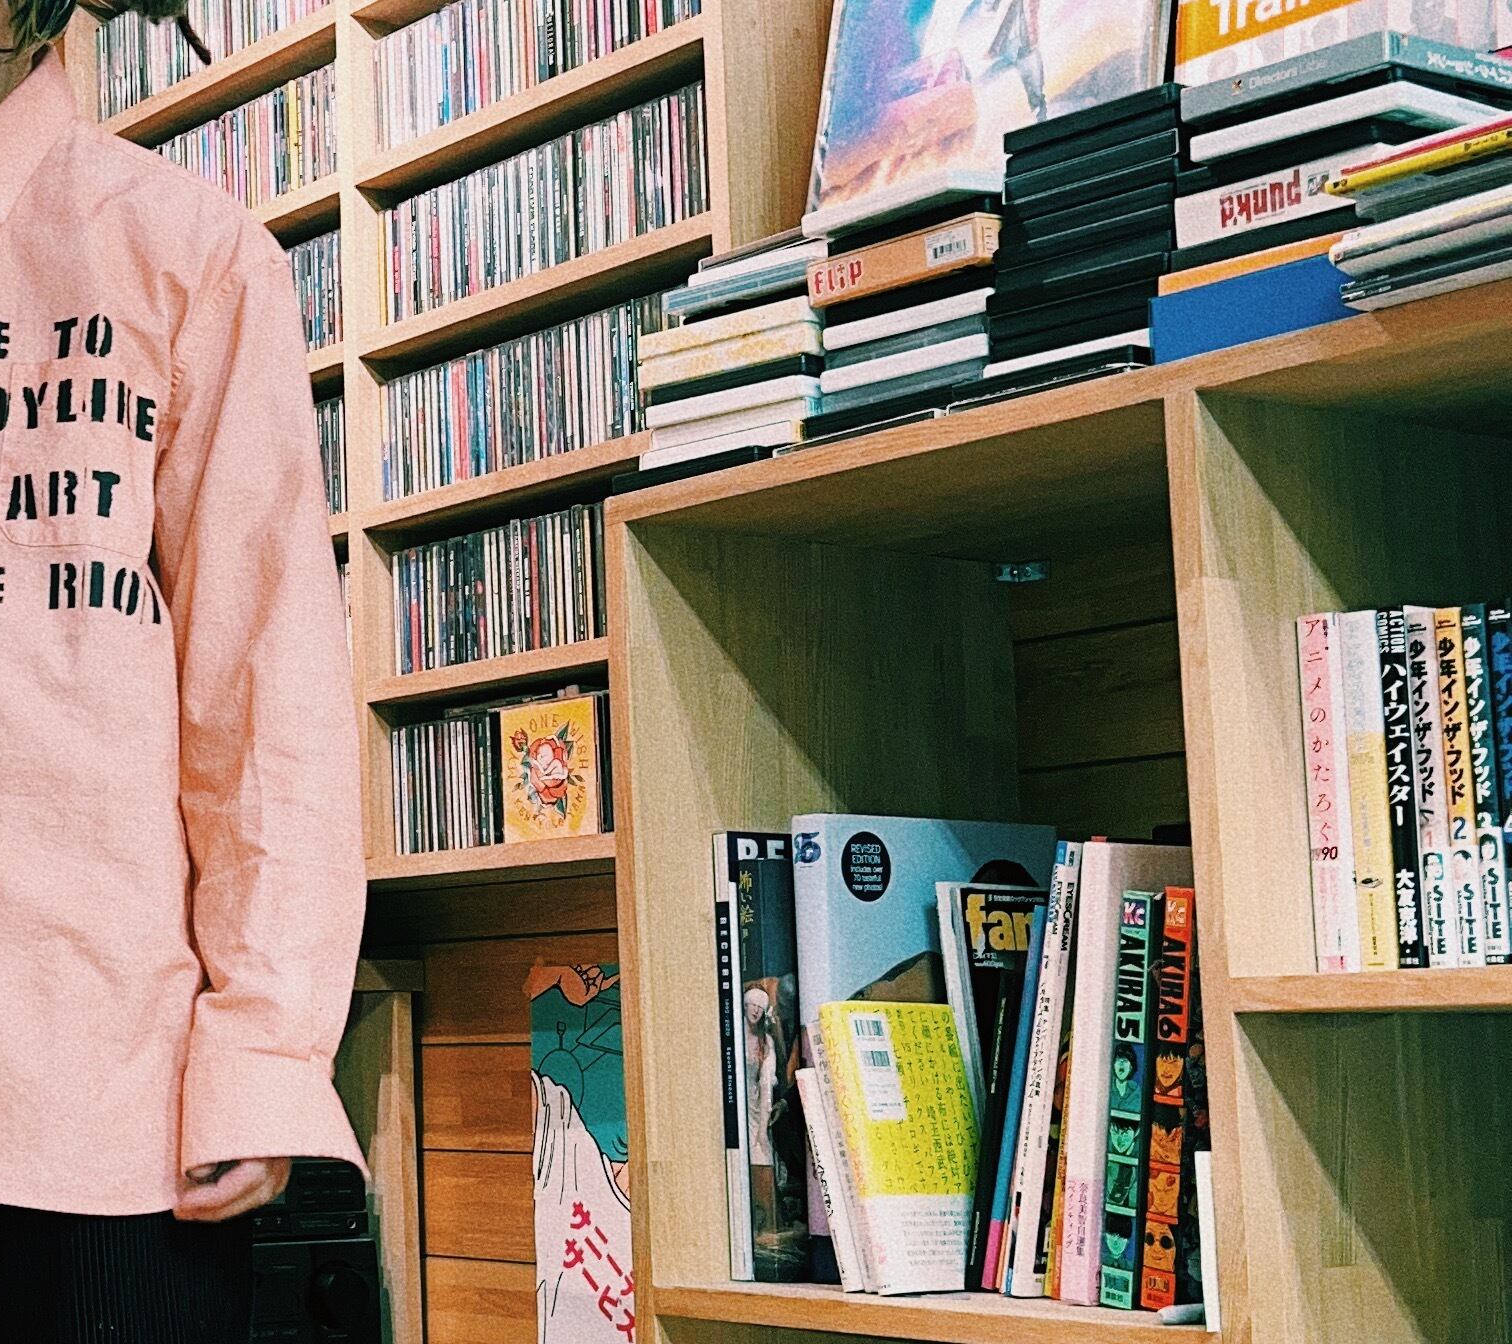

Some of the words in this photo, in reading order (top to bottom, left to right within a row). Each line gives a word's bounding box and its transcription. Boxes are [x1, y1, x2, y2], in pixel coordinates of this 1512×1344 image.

[1249, 67, 1298, 89] Directors
[52, 313, 113, 359] TO
[529, 713, 561, 733] ONE
[507, 750, 519, 779] MY
[1452, 816, 1467, 840] 2
[850, 843, 881, 854] REVISED
[851, 854, 881, 864] EDITION
[1060, 881, 1076, 952] EYESCREAM
[1487, 867, 1503, 939] SITE
[1432, 884, 1447, 955] SITE
[1462, 883, 1478, 954] SITE
[1118, 929, 1144, 1013] AKIRA
[1159, 934, 1186, 1014] AKIRA
[1116, 1014, 1139, 1041] 5
[1158, 1014, 1183, 1039] 6
